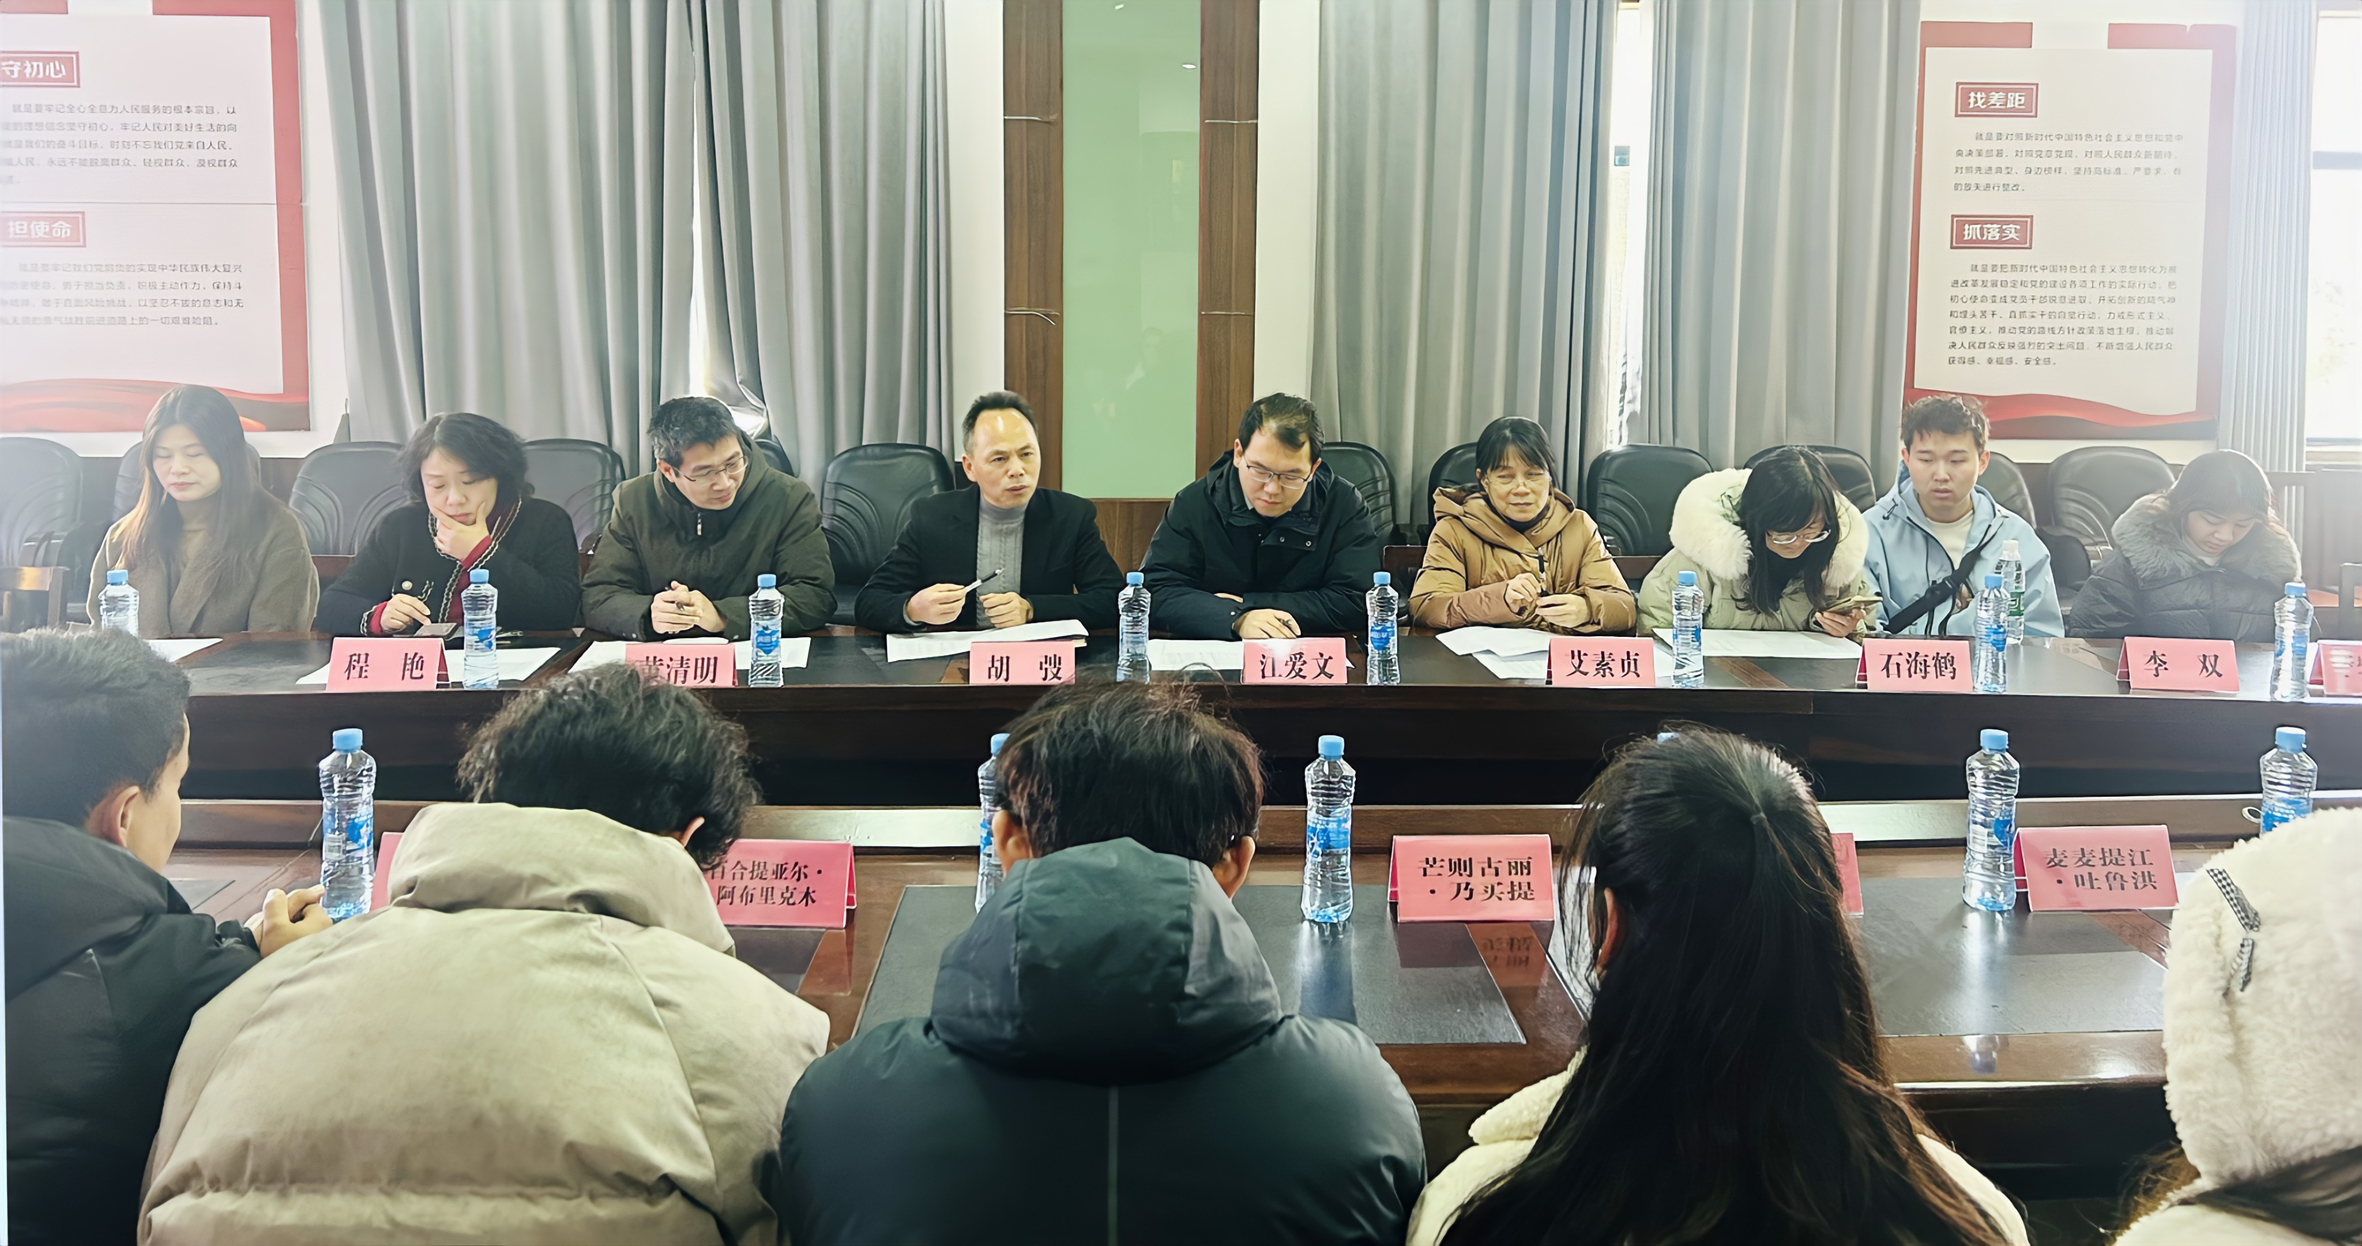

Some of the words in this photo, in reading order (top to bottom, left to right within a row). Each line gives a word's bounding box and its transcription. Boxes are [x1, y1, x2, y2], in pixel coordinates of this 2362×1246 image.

[1, 60, 66, 78] 守初心
[1968, 91, 2026, 109] 找差距
[8, 220, 71, 238] 担使命
[1963, 223, 2021, 241] 抓落实
[1565, 649, 1640, 678] 艾素贞
[1879, 651, 1957, 680] 石海鹤
[1418, 856, 1532, 878] 芒则古丽
[2044, 847, 2154, 868] 麦麦提江
[717, 885, 816, 907] 阿布里克木
